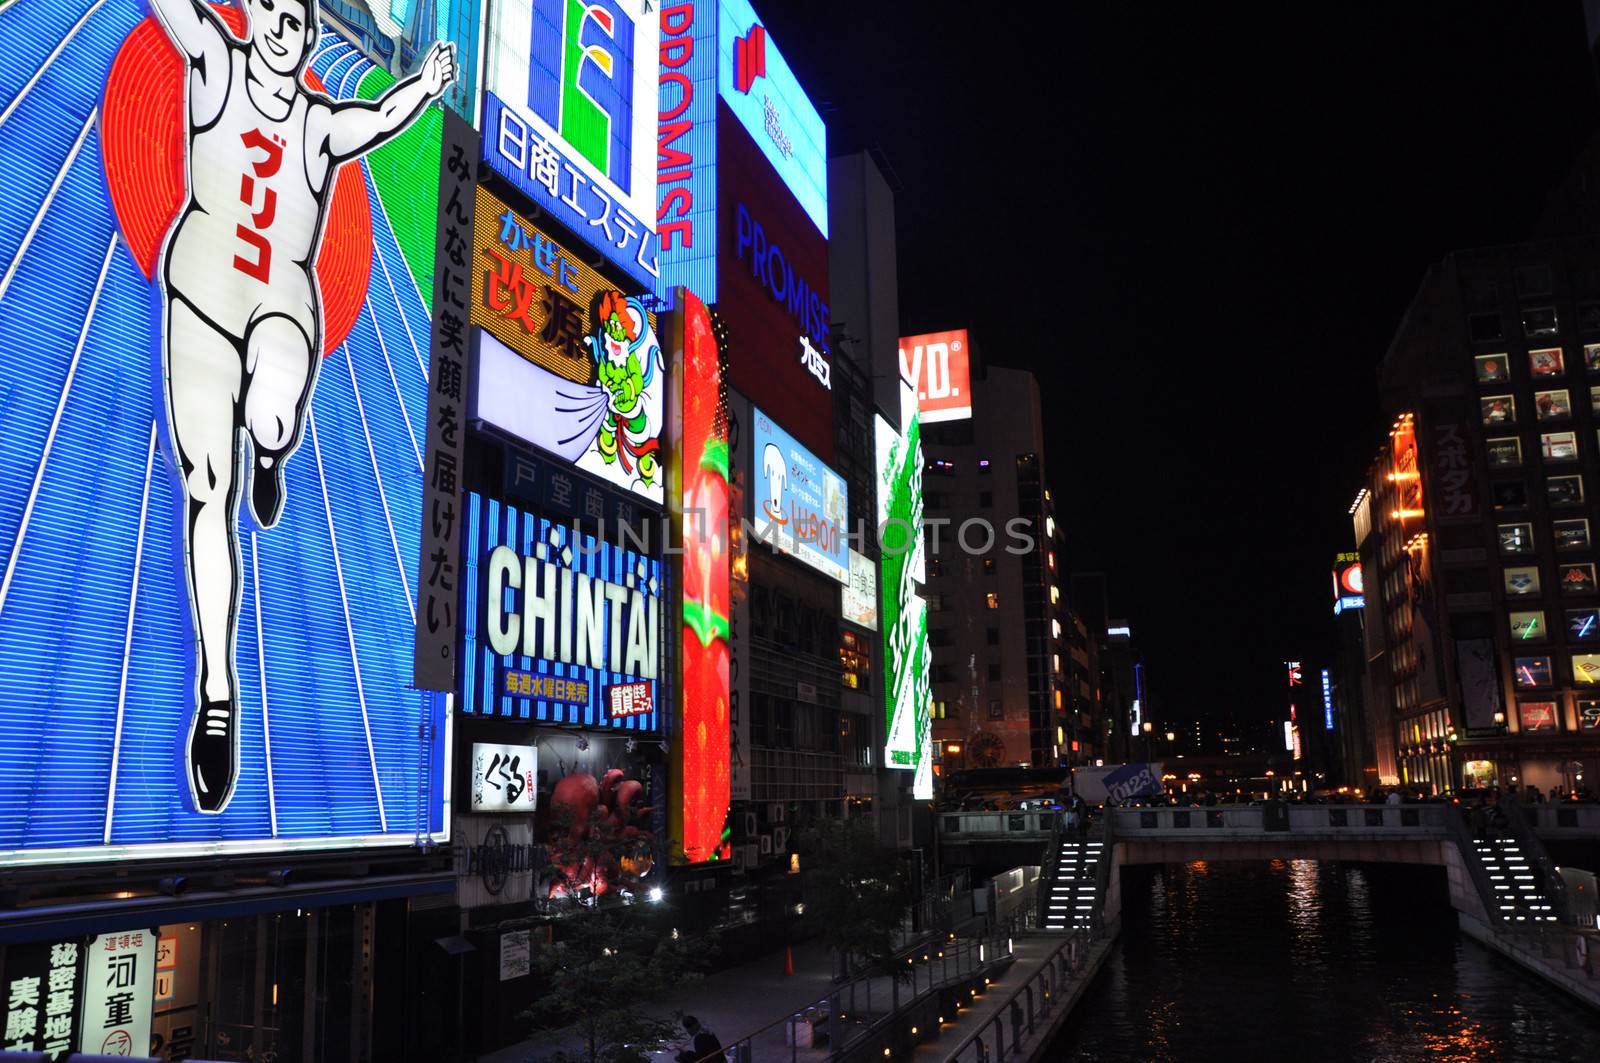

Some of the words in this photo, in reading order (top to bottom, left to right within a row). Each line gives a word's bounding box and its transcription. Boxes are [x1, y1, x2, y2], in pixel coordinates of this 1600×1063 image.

[233, 128, 287, 285] グリコ
[499, 106, 660, 278] 日商エステム
[484, 246, 587, 363] 改源
[500, 209, 580, 294] かぜに
[737, 200, 832, 354] PROMISE
[426, 144, 472, 659] みんなに笑顔を届けたい。
[506, 671, 590, 704] 毎週水曜日発売
[484, 752, 526, 804] くくる
[103, 953, 137, 1029] 河童
